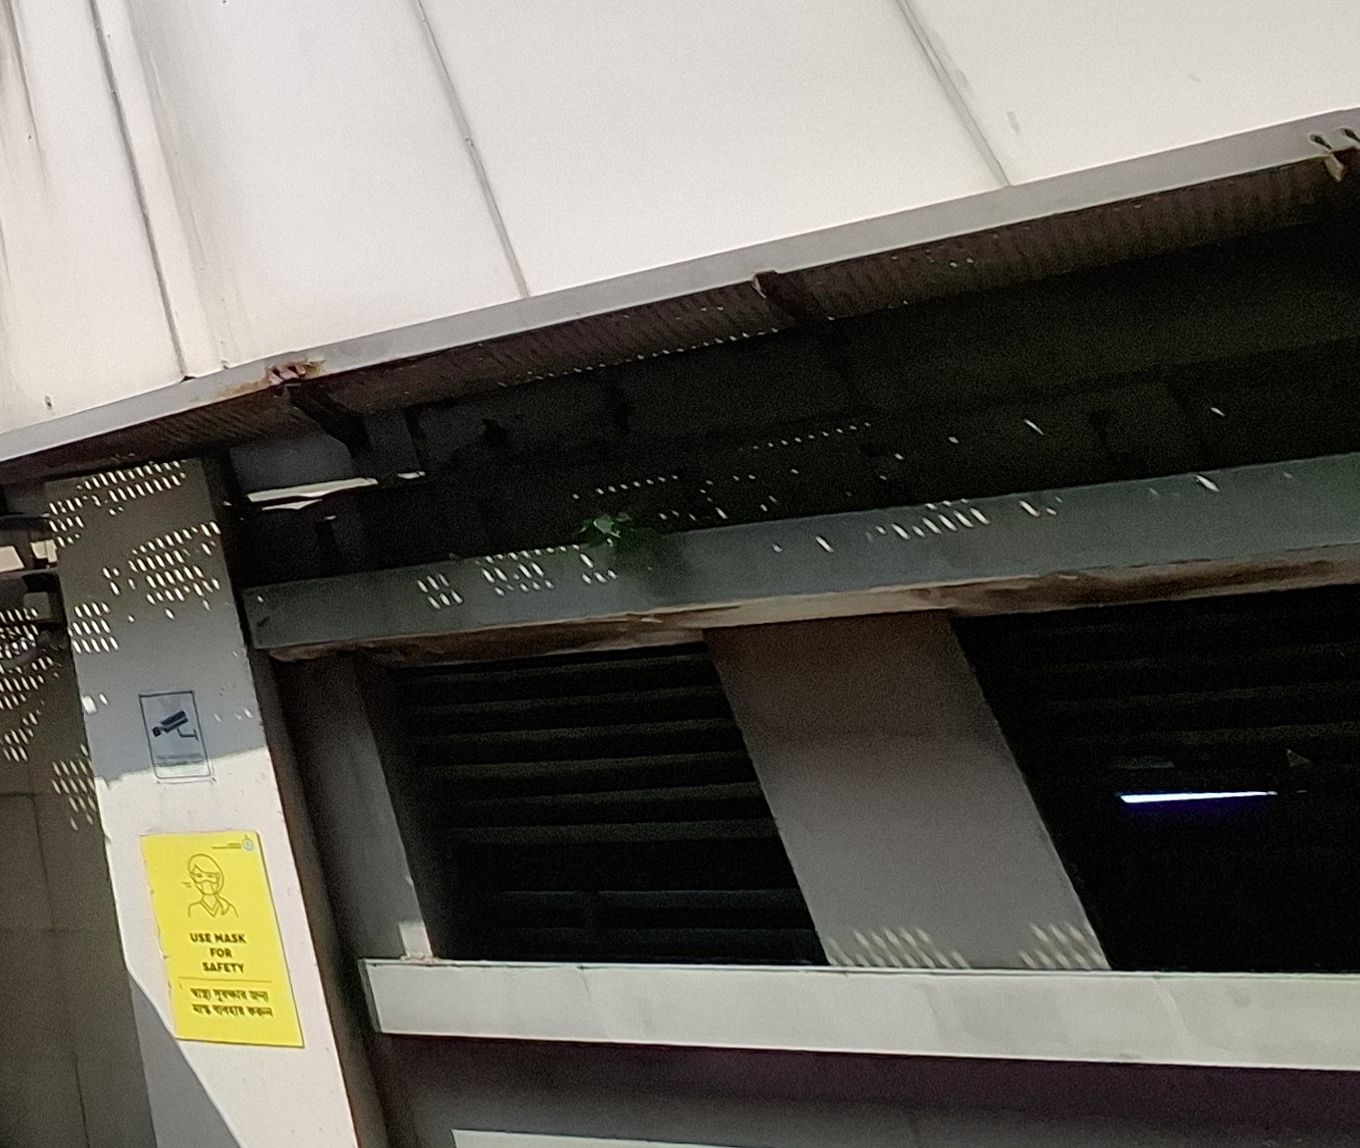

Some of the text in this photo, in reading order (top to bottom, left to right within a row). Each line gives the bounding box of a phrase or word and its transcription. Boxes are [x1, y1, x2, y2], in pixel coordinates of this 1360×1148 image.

[189, 933, 247, 944] USE MASK
[209, 947, 233, 958] FOR
[202, 962, 245, 974] SAFETY
